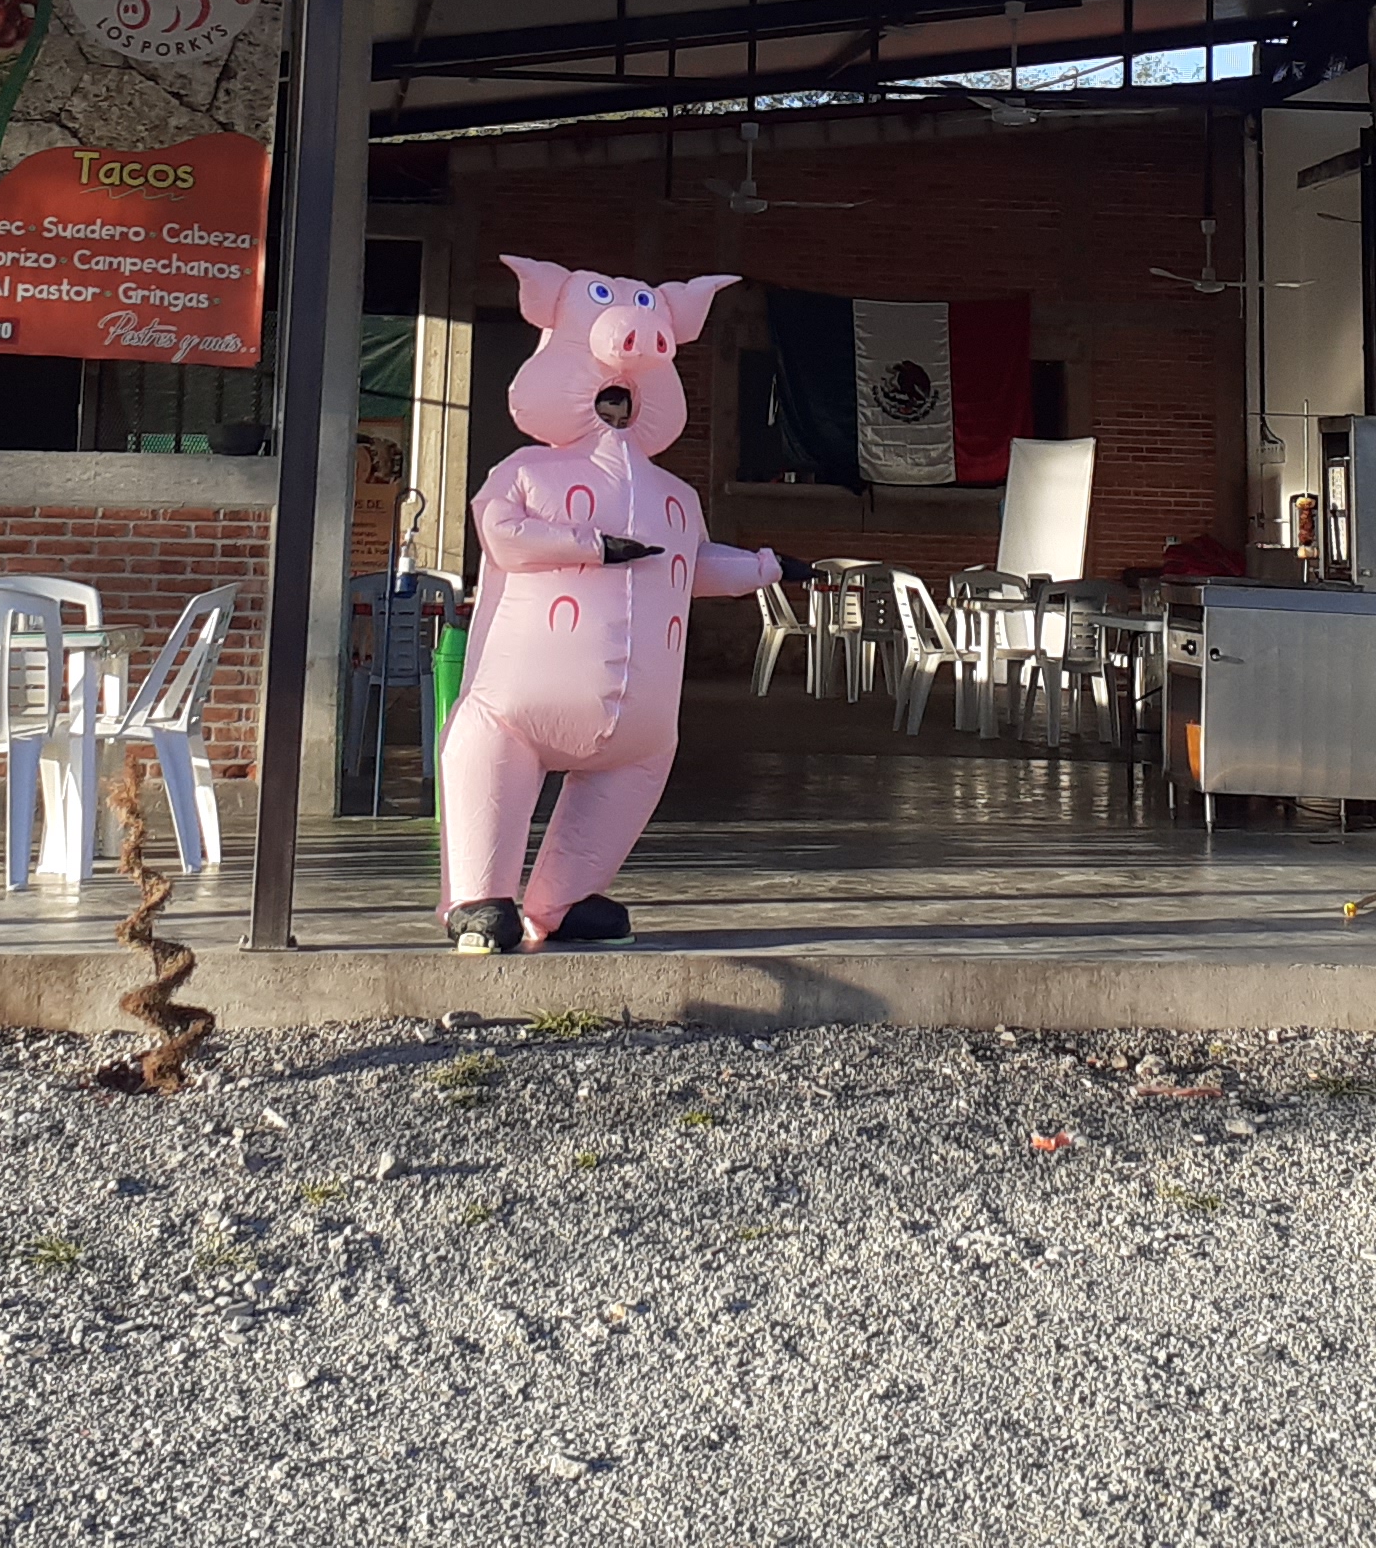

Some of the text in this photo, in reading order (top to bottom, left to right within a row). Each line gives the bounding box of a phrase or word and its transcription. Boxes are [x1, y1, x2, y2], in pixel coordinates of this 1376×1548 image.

[96, 17, 228, 56] LOS PORKY'S
[74, 151, 195, 189] Tacos
[42, 217, 146, 242] Suadero
[162, 223, 252, 250] Cabeza
[73, 250, 242, 280] Campechanos
[16, 280, 101, 302] pastor
[118, 282, 209, 313] Gringas
[98, 310, 177, 348] Postres
[171, 338, 201, 363] y
